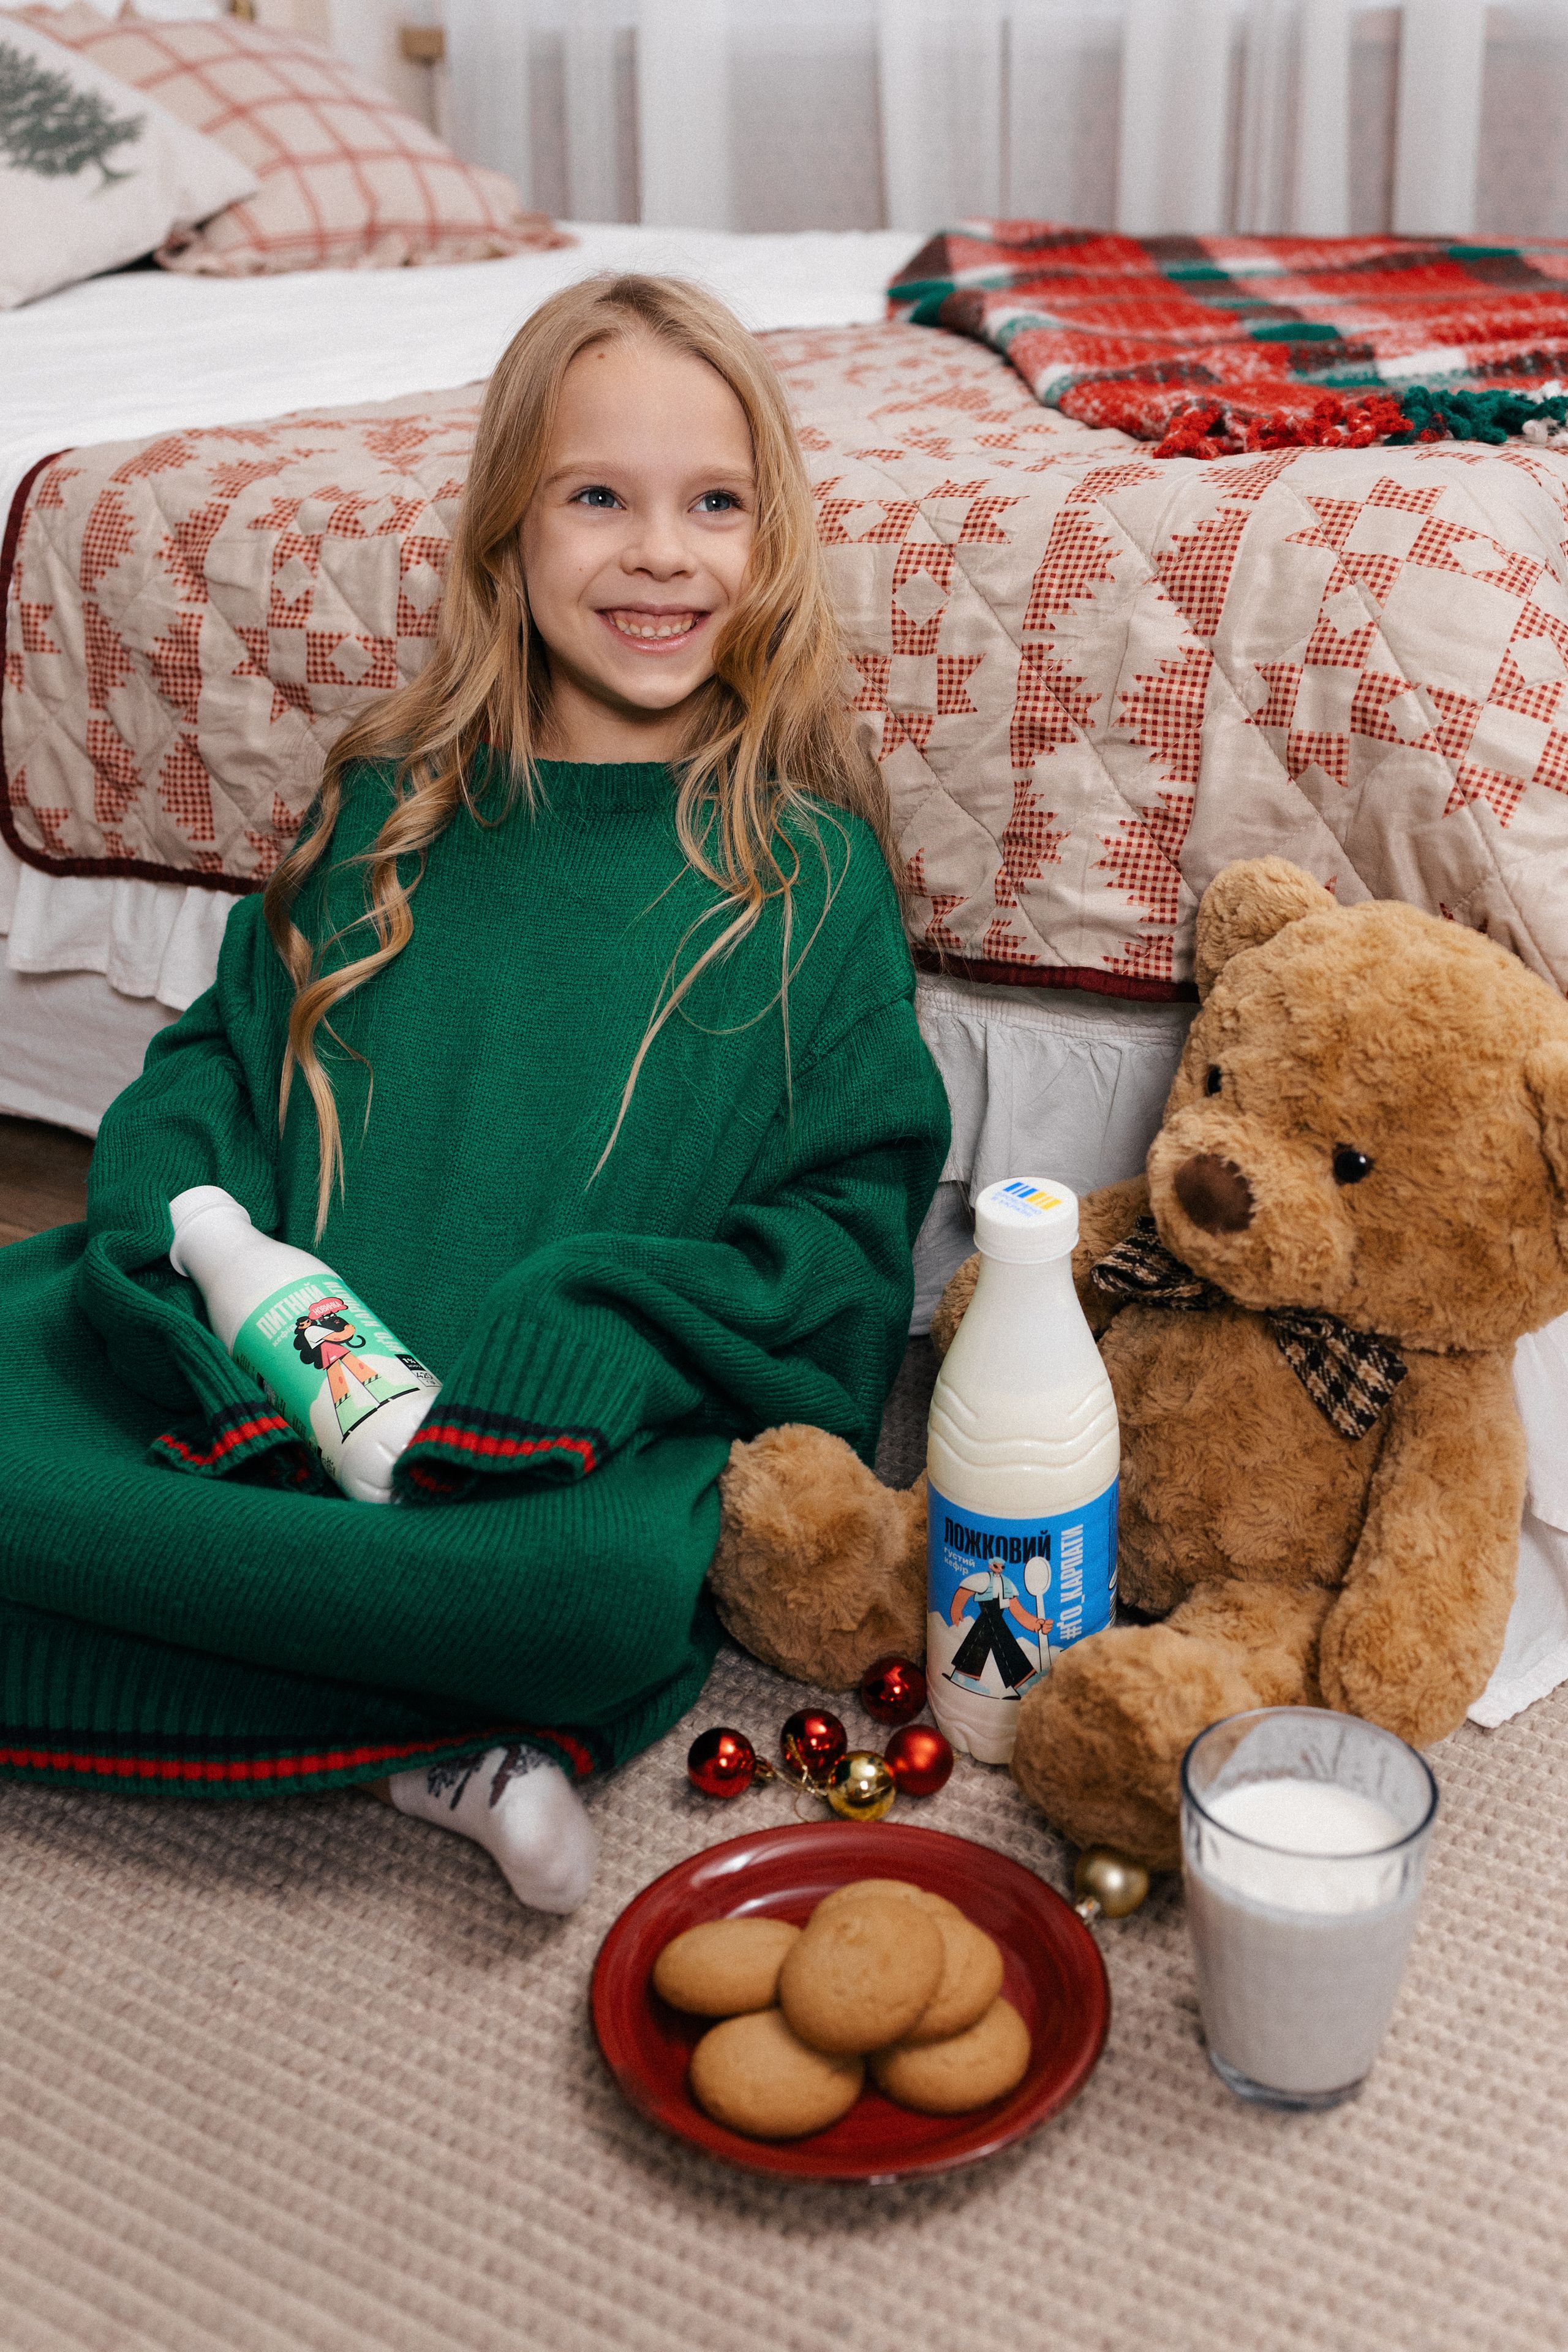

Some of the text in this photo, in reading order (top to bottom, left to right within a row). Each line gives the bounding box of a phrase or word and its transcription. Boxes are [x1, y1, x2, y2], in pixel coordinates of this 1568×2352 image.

[256, 1282, 326, 1340] ПИТНИЙ
[312, 1301, 342, 1316] НОВИНКА
[944, 1517, 1051, 1564] ЛОЖКОВИЙ
[944, 1547, 975, 1568] густий
[944, 1558, 969, 1575] кефір
